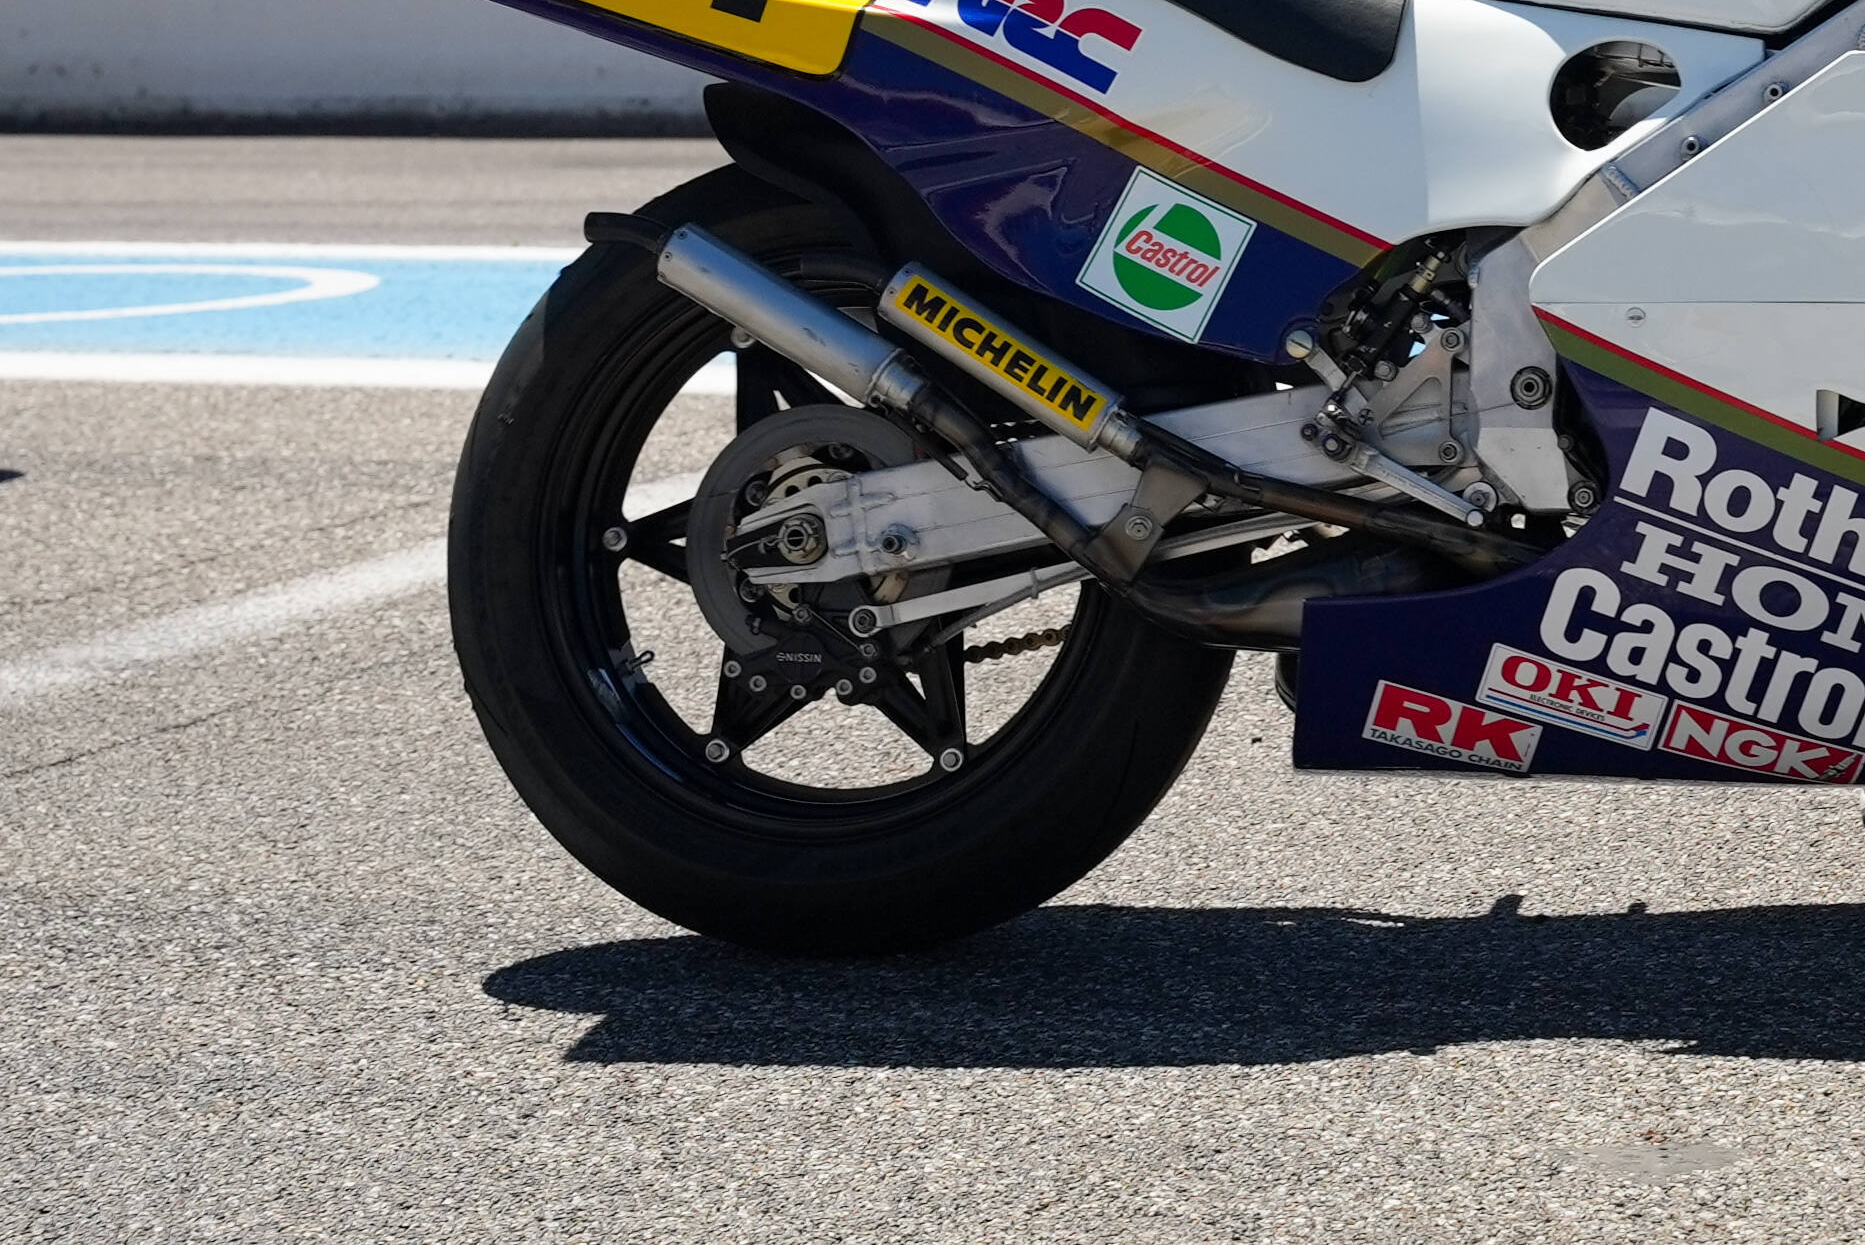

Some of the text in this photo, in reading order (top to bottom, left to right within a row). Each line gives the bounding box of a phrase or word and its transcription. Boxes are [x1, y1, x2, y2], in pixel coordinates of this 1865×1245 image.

[1125, 229, 1221, 289] Castrol
[902, 280, 1098, 423] MICHELIN
[785, 652, 823, 664] NISSIN
[1500, 654, 1644, 722] OKI
[1372, 682, 1536, 763] RK
[1528, 693, 1606, 722] ELECTRONIC DEVICES
[1369, 727, 1524, 772] TAKASAGO CHAIN
[1668, 708, 1832, 780] NGK
